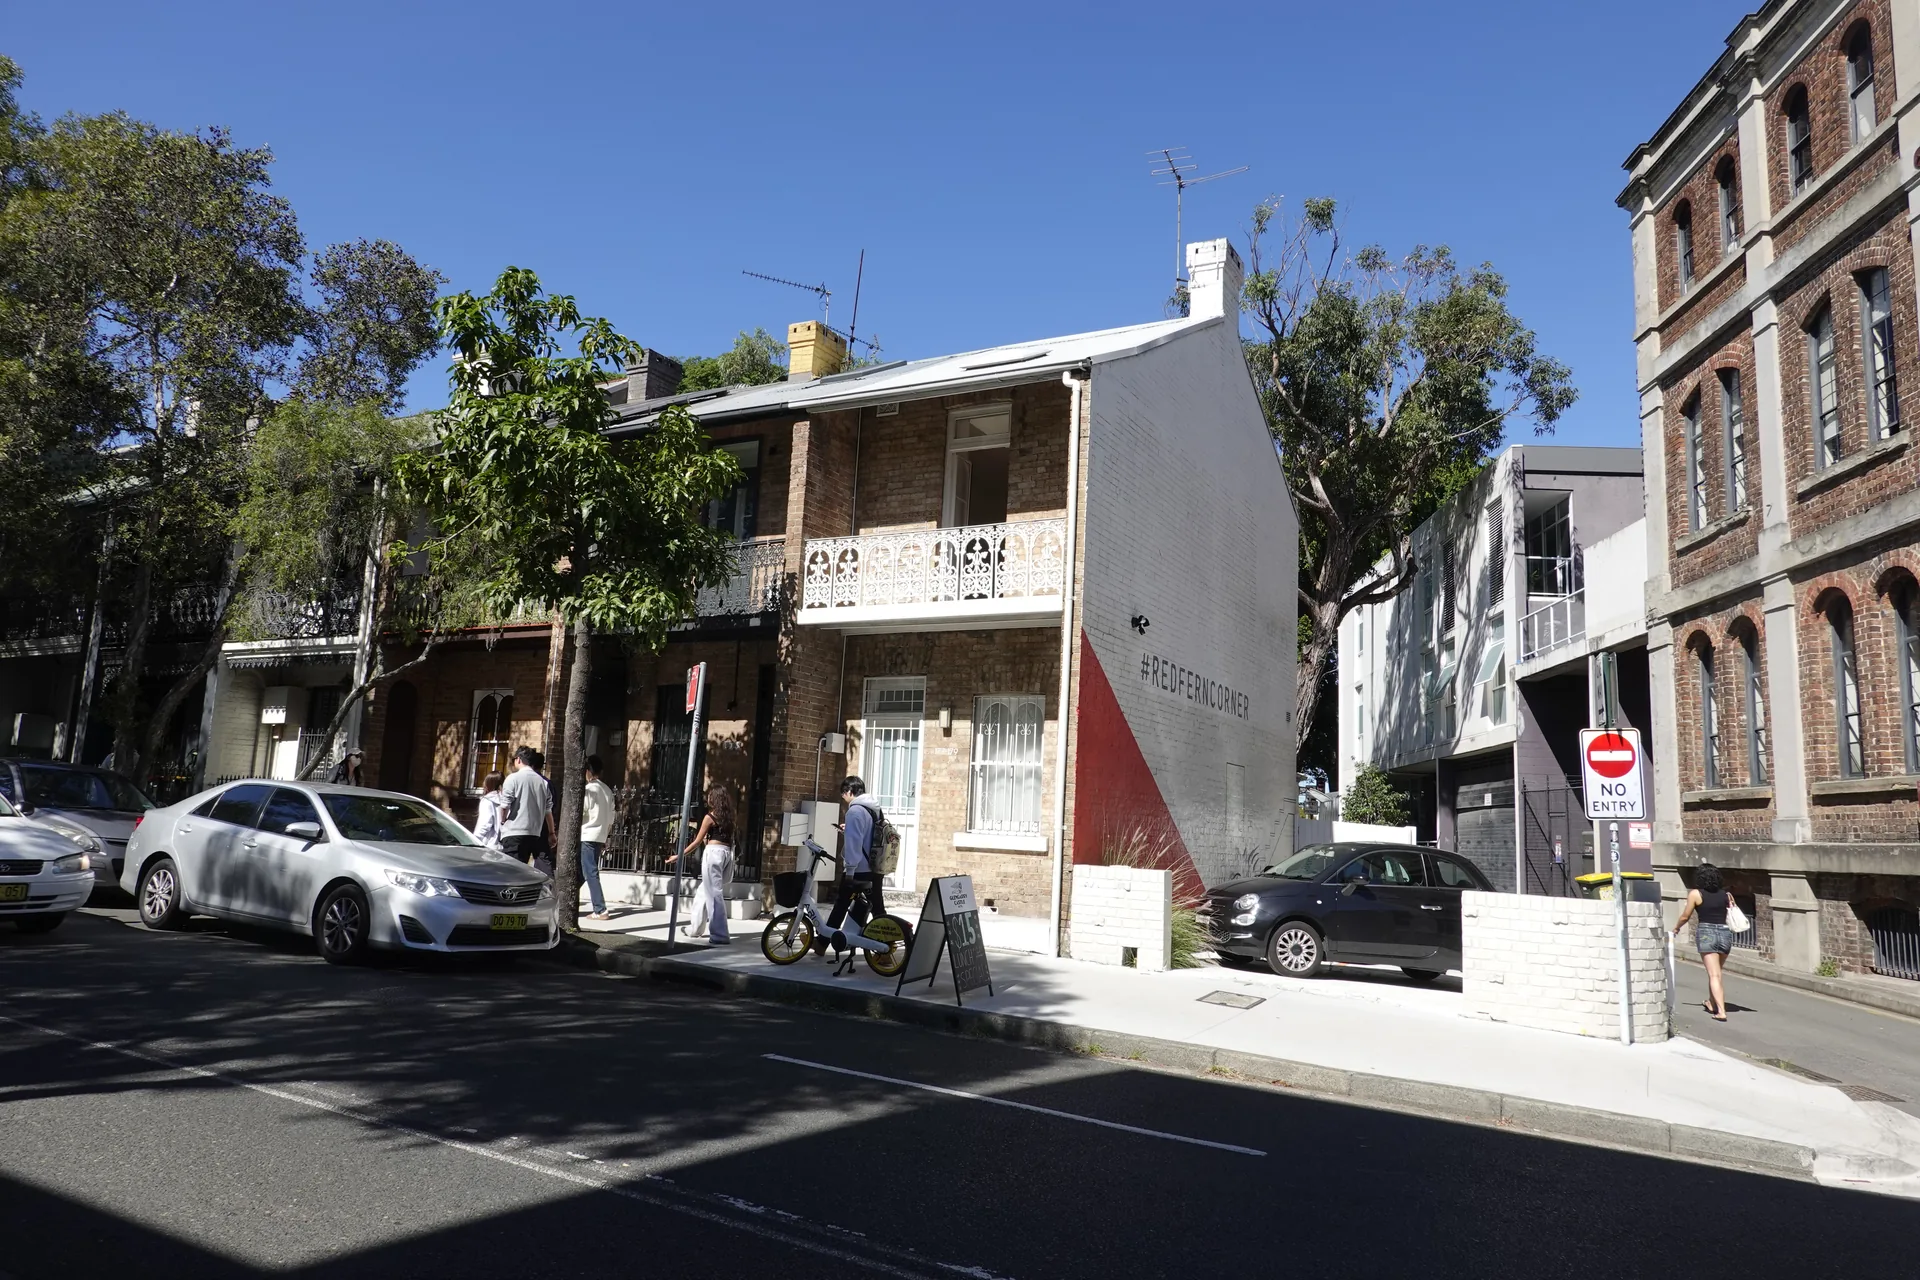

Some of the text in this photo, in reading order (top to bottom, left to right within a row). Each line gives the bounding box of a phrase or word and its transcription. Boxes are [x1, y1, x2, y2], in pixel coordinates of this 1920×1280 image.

[1141, 652, 1249, 721] #REDFERNCORNER
[1601, 783, 1626, 796] NO
[1593, 801, 1636, 812] ENTRY
[951, 911, 976, 949] $15
[952, 949, 974, 969] LUNCH
